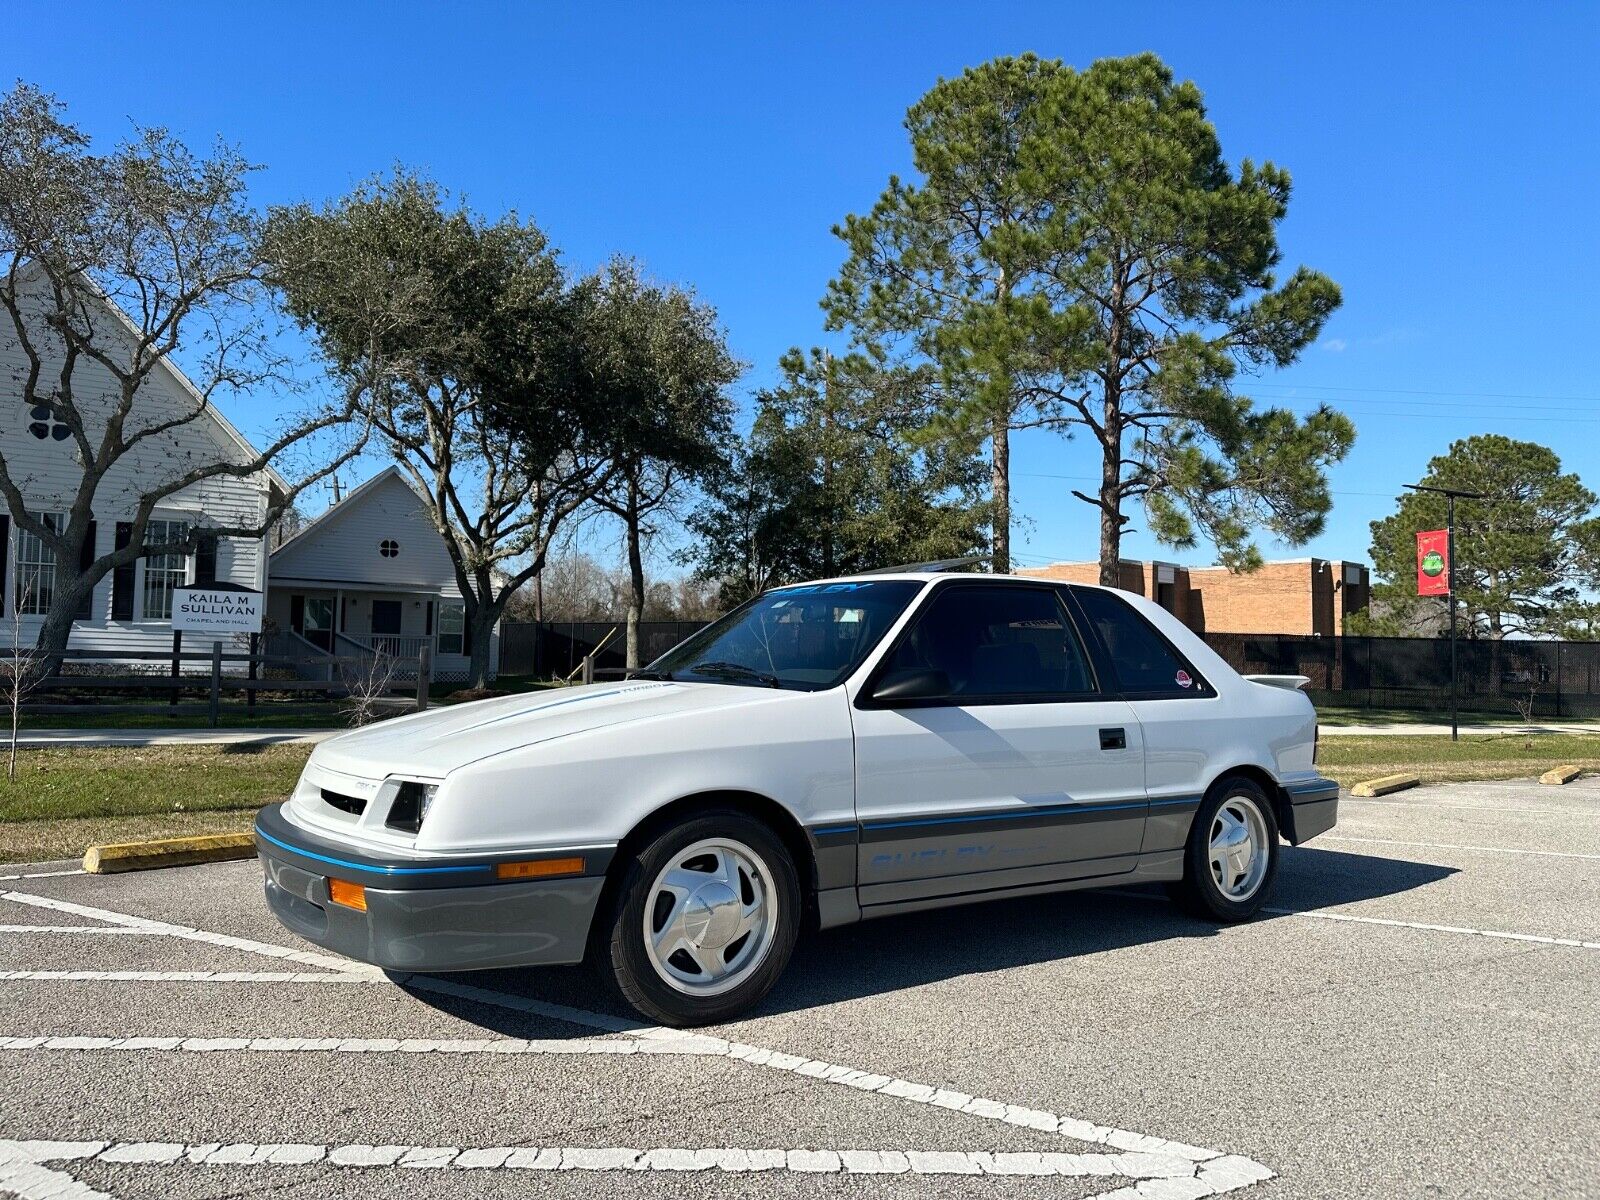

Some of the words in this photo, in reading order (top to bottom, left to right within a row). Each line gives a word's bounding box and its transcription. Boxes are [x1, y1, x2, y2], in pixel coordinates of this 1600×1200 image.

[188, 594, 232, 604] KAILA
[238, 596, 249, 605] M
[180, 604, 255, 615] SULLIVAN
